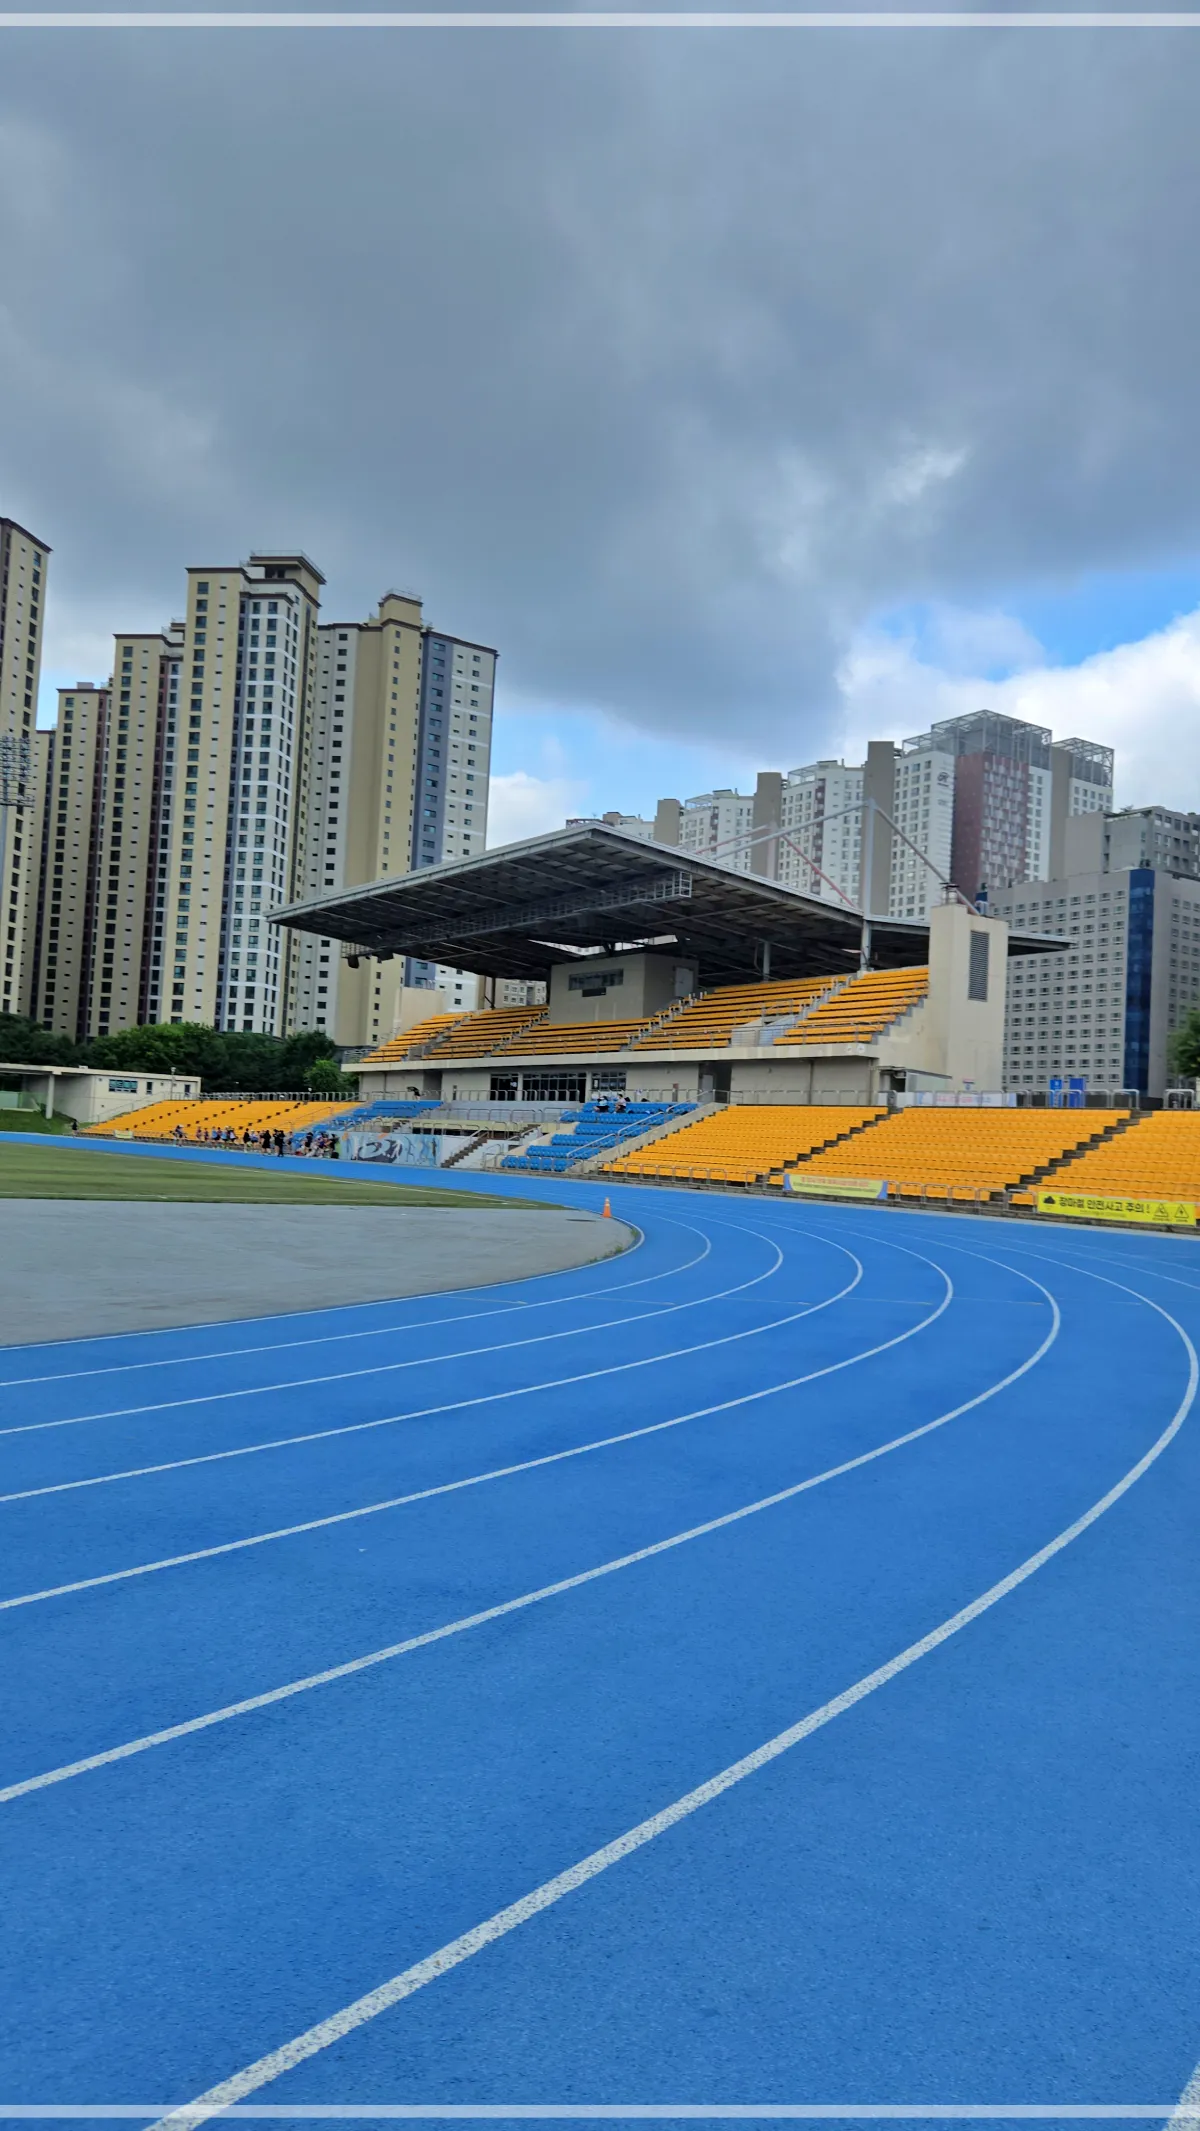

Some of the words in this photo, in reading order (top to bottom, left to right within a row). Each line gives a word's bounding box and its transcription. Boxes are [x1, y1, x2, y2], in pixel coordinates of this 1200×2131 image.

[1058, 1196, 1084, 1208] 장마철
[1087, 1200, 1123, 1211] 안전사고
[1125, 1202, 1144, 1213] 주의
